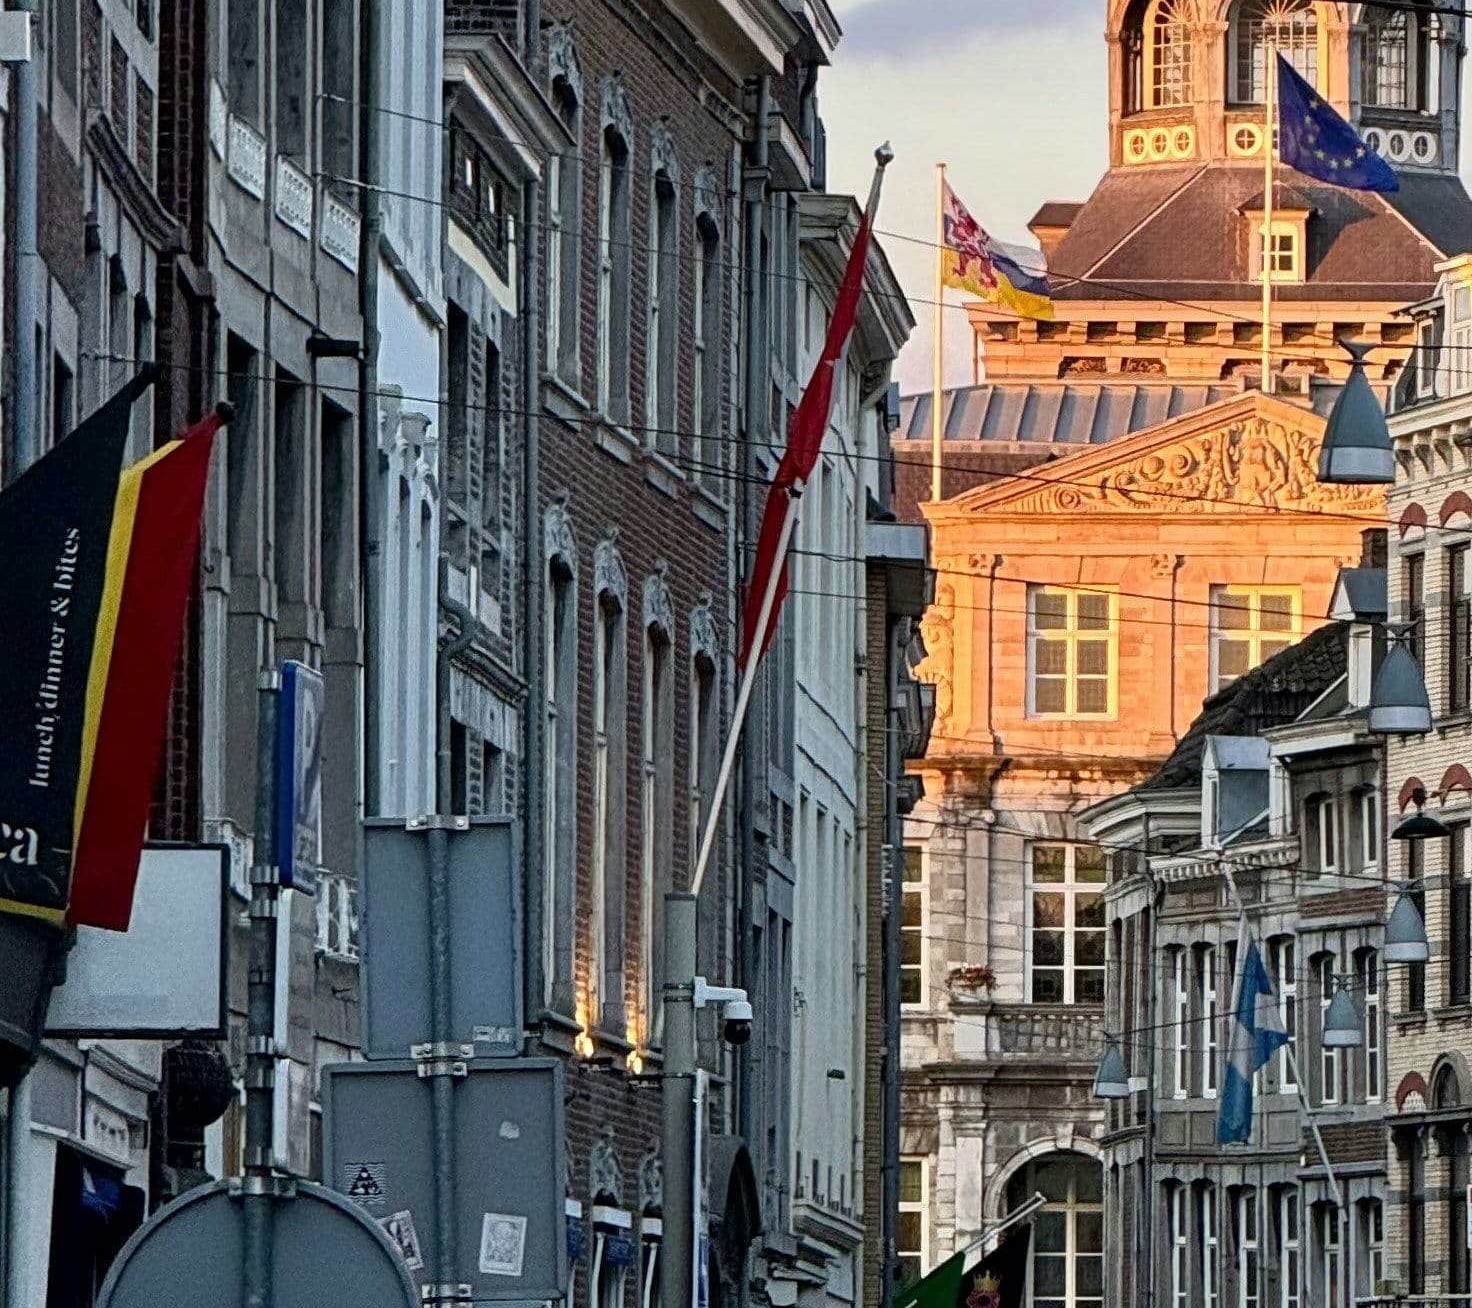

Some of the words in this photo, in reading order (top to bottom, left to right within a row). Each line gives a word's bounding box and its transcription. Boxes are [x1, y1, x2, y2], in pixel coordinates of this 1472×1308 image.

[53, 527, 80, 590] bites
[50, 596, 70, 617] &
[39, 622, 66, 710] dinner
